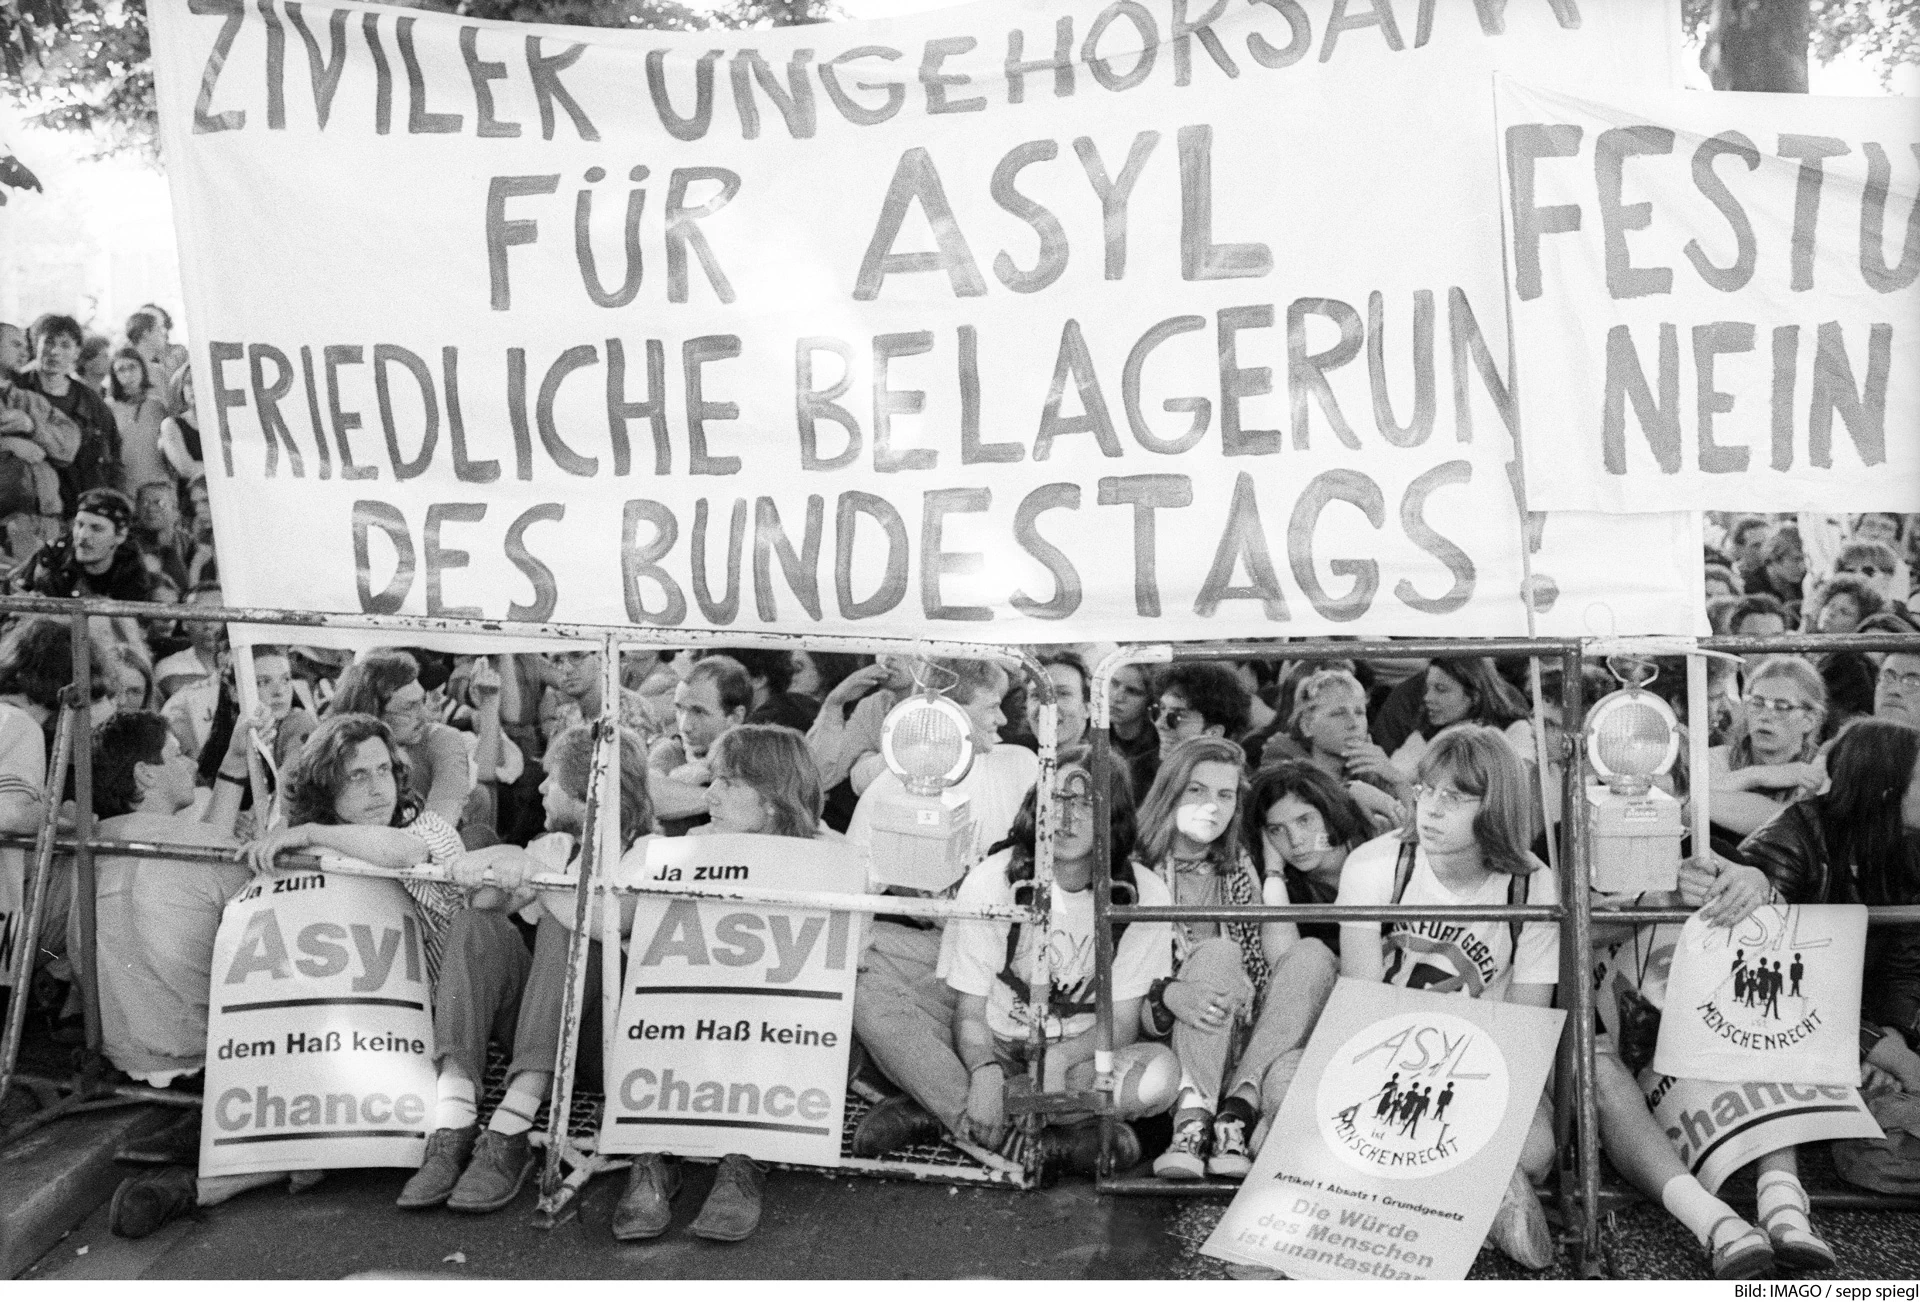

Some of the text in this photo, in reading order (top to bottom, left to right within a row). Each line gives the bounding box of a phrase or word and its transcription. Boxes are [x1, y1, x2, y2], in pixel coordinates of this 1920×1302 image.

[485, 123, 1274, 311] FÜR ASYL
[209, 334, 743, 483] FRIEDLICHE
[1604, 320, 1893, 476] NEIN
[351, 500, 566, 623] DES
[273, 874, 325, 893] zum
[653, 864, 749, 881] Ja zum
[224, 908, 423, 993] Asyl
[641, 900, 852, 984] Asyl
[217, 1031, 425, 1060] dem Haß keine
[627, 1018, 838, 1048] dem Haß keine
[1352, 1024, 1491, 1080] ASYL
[1697, 1001, 1822, 1050] MENSCHENRECHT
[214, 1085, 425, 1132] Chance
[618, 1067, 831, 1122] Chance
[1273, 1171, 1315, 1189] Artikel
[1326, 1184, 1368, 1201] Absatz
[1382, 1196, 1465, 1222] Grundgesetz
[1291, 1198, 1420, 1243] Die Würde
[1238, 1228, 1269, 1248] ist
[1257, 1213, 1434, 1269] des Menschen
